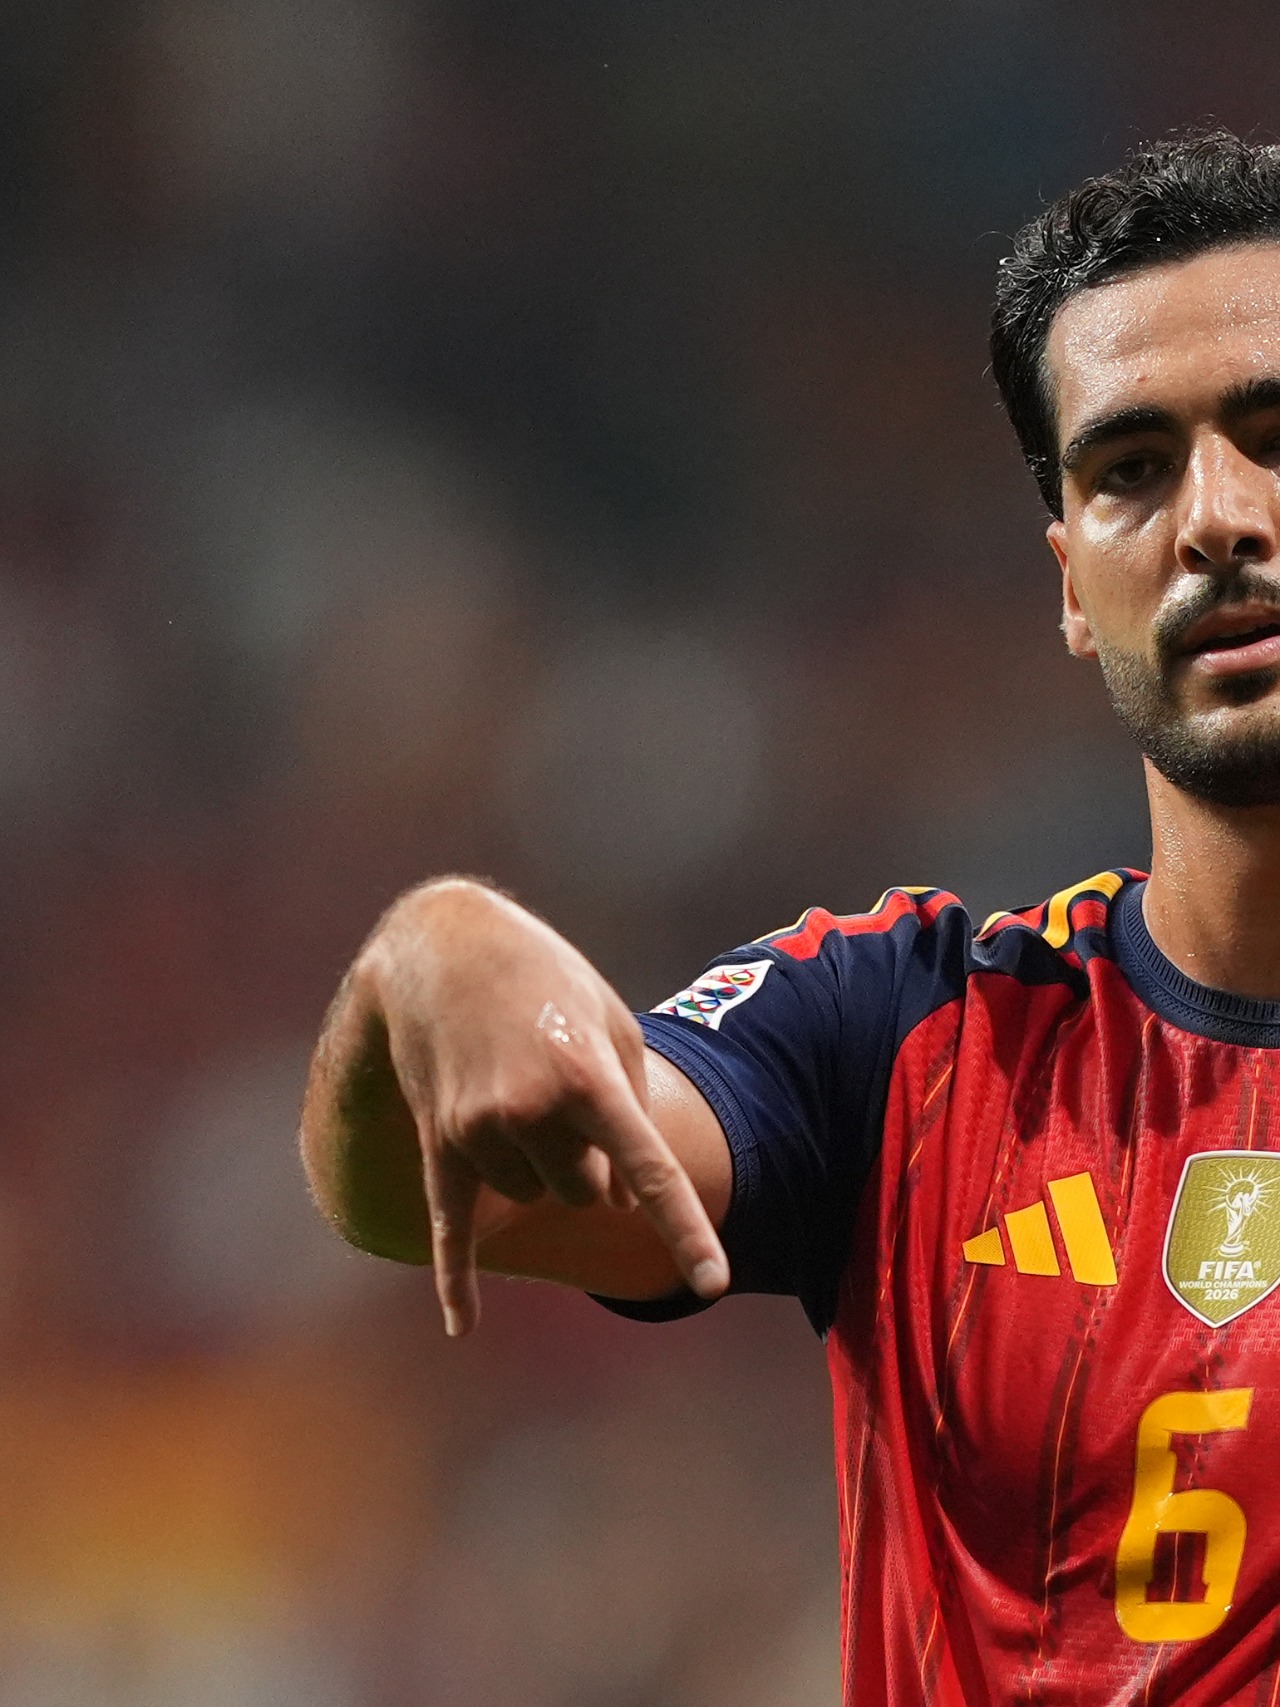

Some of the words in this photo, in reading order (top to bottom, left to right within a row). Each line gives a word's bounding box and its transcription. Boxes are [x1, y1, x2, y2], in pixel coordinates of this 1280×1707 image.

[1198, 1261, 1254, 1280] FIFA
[1179, 1281, 1212, 1289] WORLD
[1213, 1280, 1268, 1289] CHAMPIONS
[1204, 1289, 1239, 1300] 2026
[1114, 1387, 1254, 1642] 6
